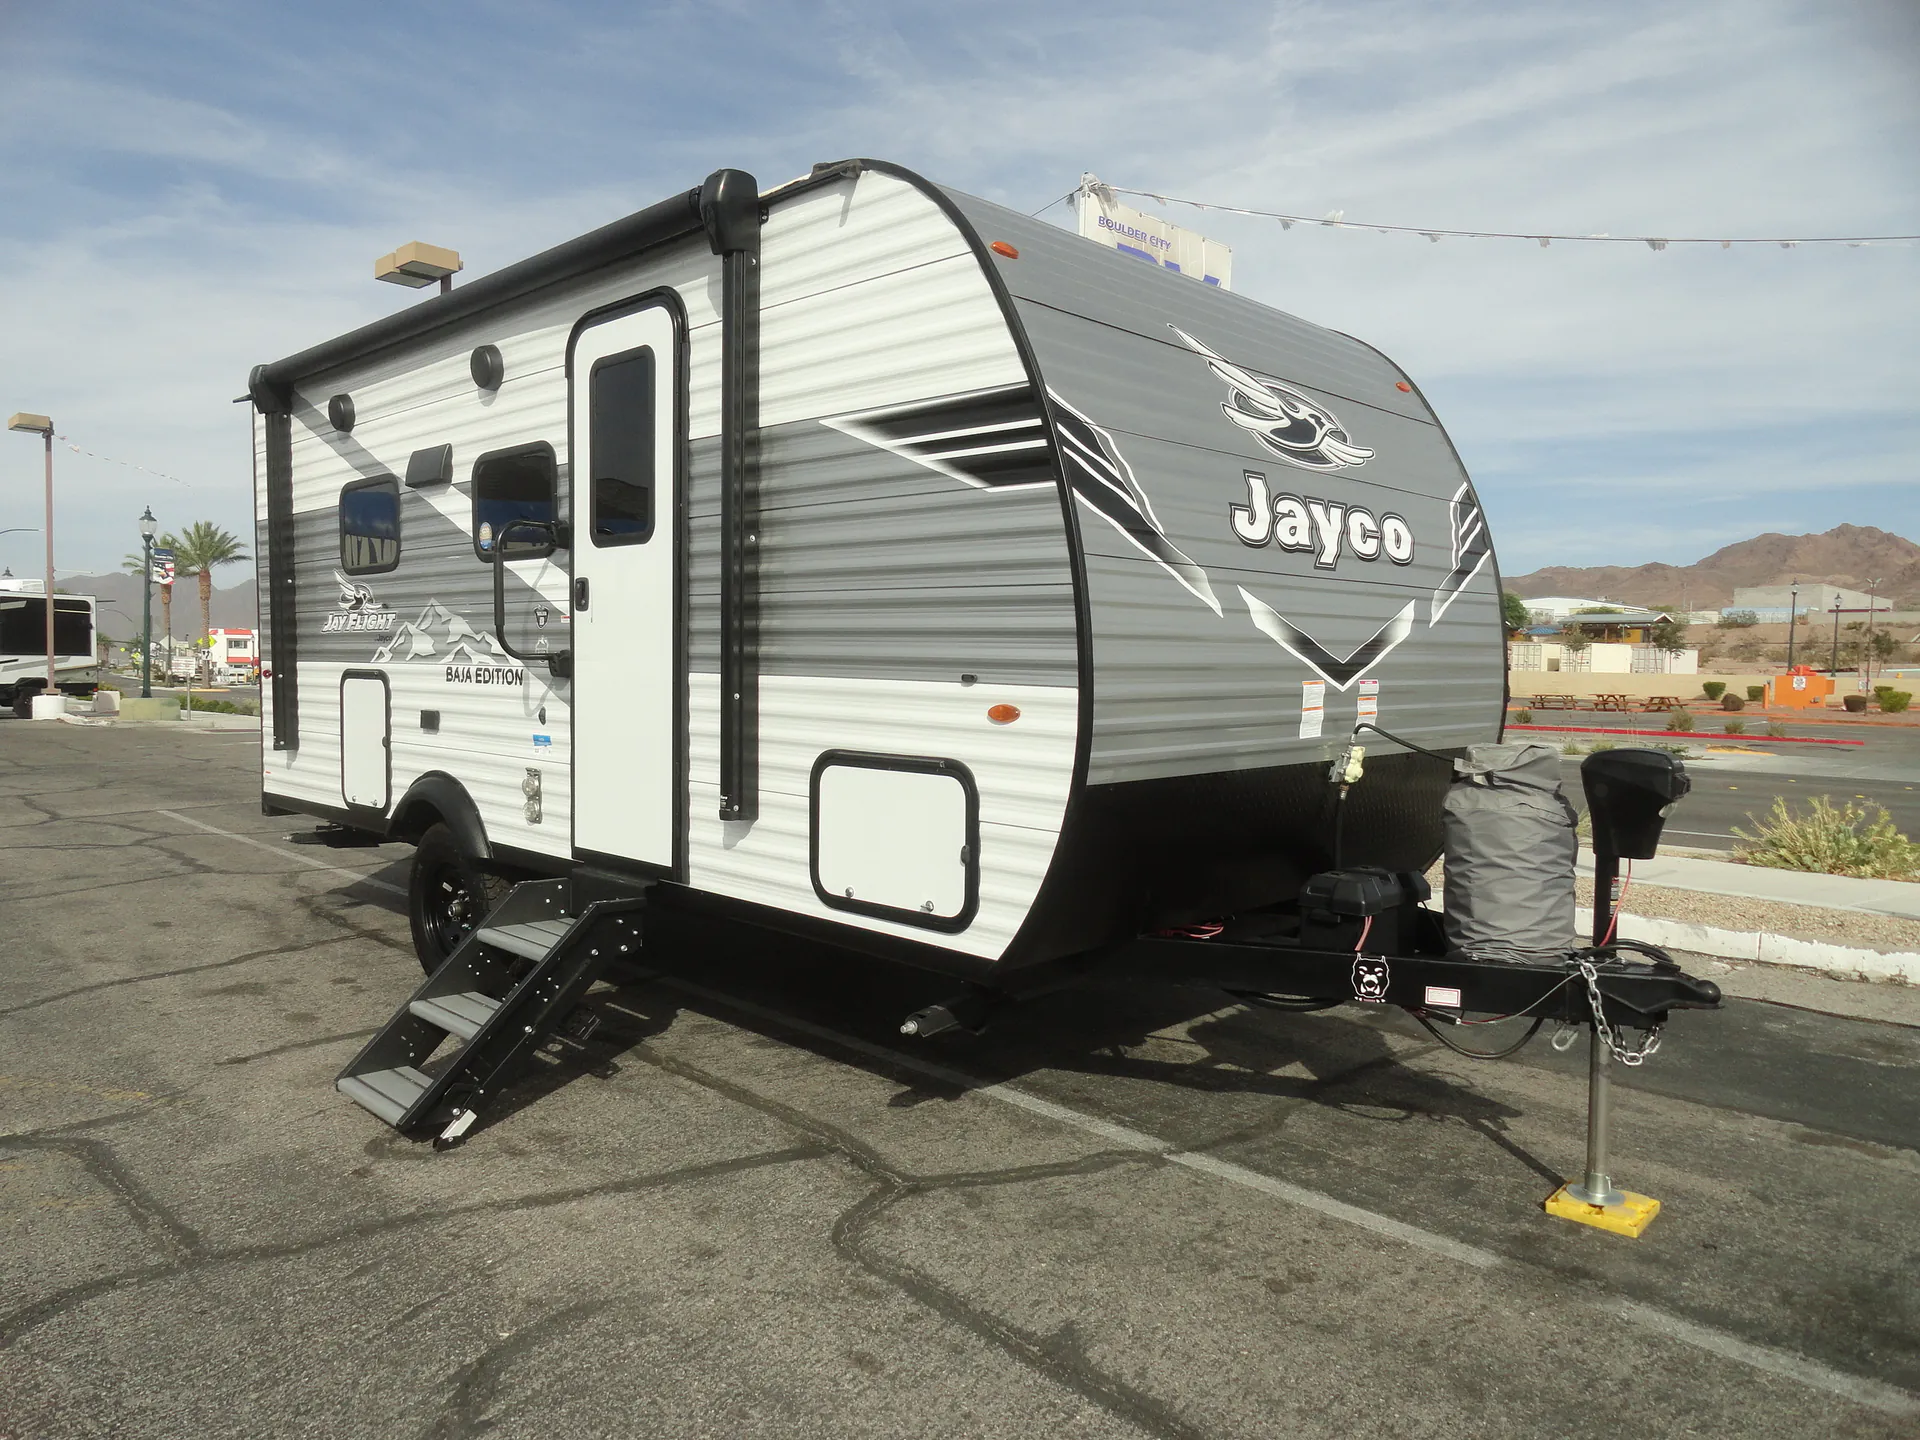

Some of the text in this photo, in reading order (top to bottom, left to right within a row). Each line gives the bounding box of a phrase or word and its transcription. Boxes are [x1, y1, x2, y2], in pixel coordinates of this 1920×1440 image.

[1098, 216, 1171, 252] BOULDER CITY
[1229, 469, 1415, 571] Jayco
[322, 612, 396, 632] JAY FLIGHT
[446, 666, 524, 686] BAJA EDITION
